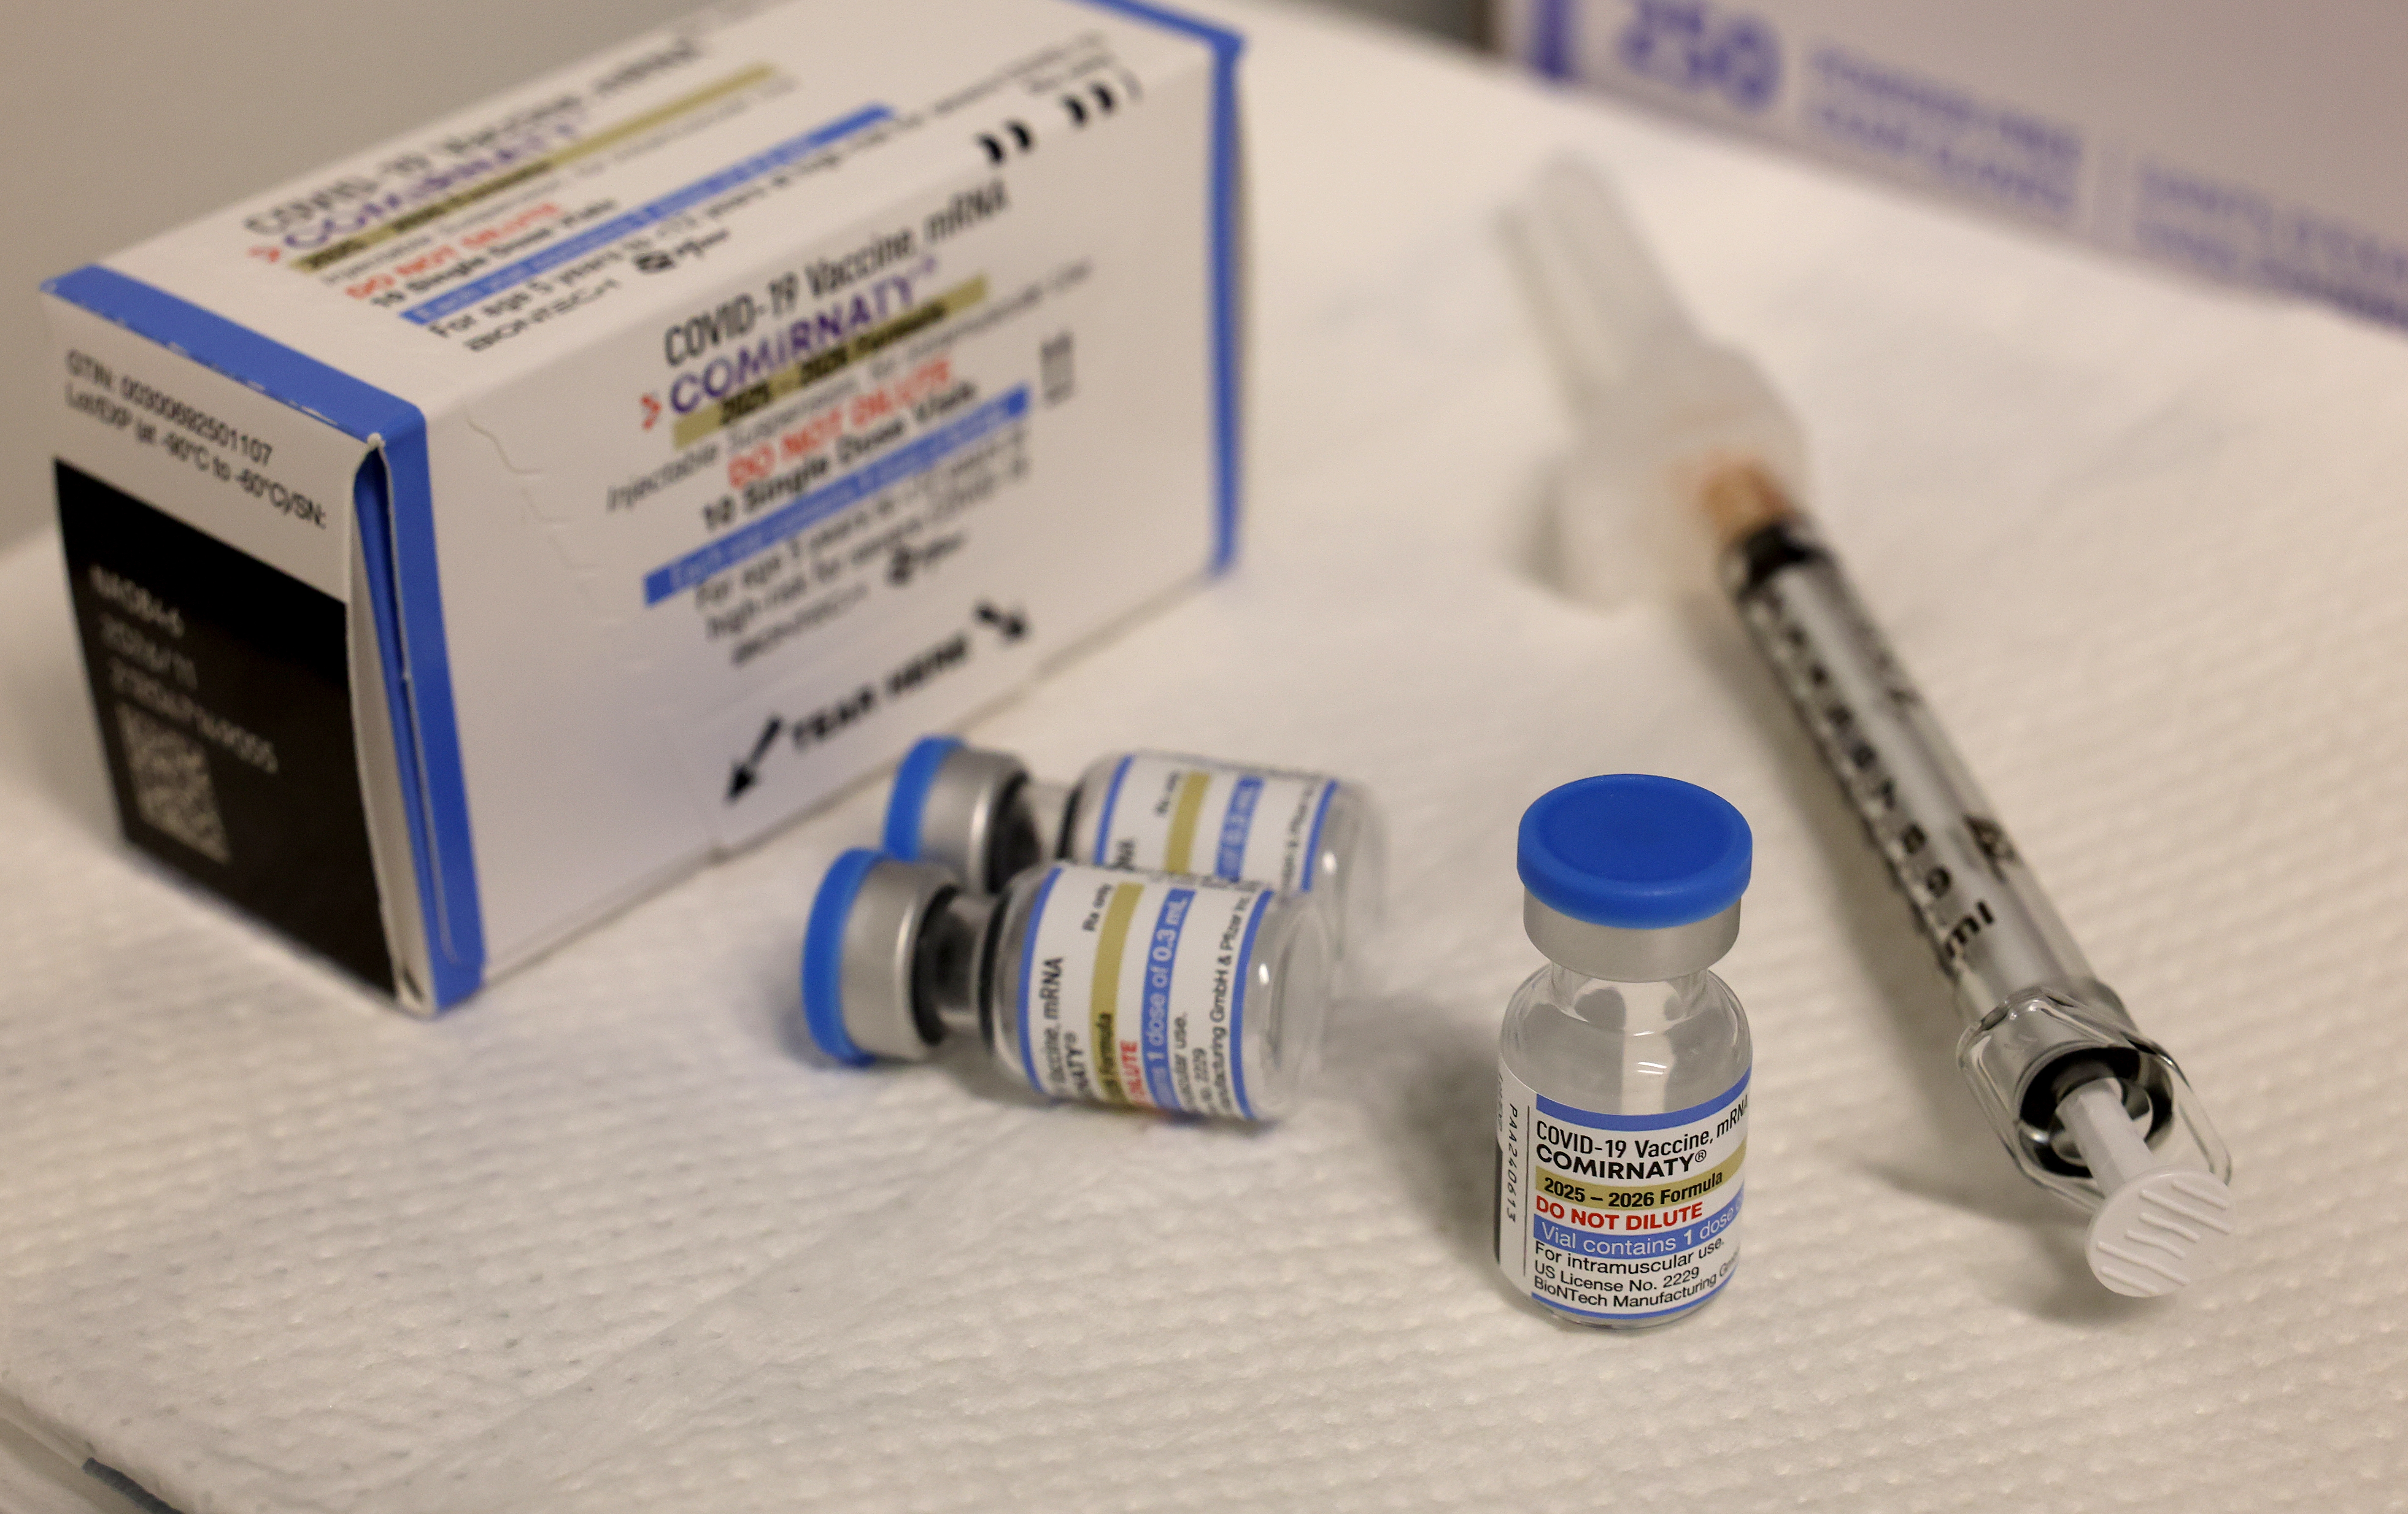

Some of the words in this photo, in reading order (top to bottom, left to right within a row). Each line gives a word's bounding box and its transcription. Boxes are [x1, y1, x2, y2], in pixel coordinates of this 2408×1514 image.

[664, 269, 799, 367] COVID-19
[924, 177, 1009, 245] mRNA
[727, 441, 777, 490] DO
[780, 403, 844, 464] NOT
[702, 494, 736, 532] 10
[742, 453, 831, 514] Single
[1081, 911, 1100, 932] Rx
[1220, 914, 1242, 951] Pfizer
[1152, 929, 1177, 962] 0.3
[1217, 955, 1232, 967] &
[1038, 955, 1064, 1020] mRNA
[1150, 965, 1169, 989] of
[1209, 969, 1228, 1023] GmbH
[1145, 993, 1167, 1046] dose
[1173, 1013, 1188, 1049] use.
[1147, 1052, 1164, 1061] 1
[1192, 1047, 1210, 1082] 2229
[1537, 1120, 1627, 1159] COVID-19
[1634, 1130, 1714, 1159] Vaccine,
[1506, 1103, 1518, 1223] PAA240613
[1536, 1143, 1707, 1180] COMIRNATY®
[1544, 1177, 1585, 1203] 2025
[1608, 1192, 1655, 1208] 2026
[1660, 1172, 1722, 1205] Formula
[1536, 1195, 1565, 1219] DO
[1571, 1208, 1620, 1230] NOT
[1625, 1201, 1703, 1231] DILUTE
[1542, 1221, 1576, 1249] Vial
[1583, 1237, 1676, 1255] contains
[1683, 1229, 1693, 1245] 1
[1699, 1207, 1733, 1240] dose
[1535, 1240, 1563, 1263] For
[1567, 1252, 1694, 1275] intramuscular
[1698, 1238, 1725, 1259] use.
[1534, 1275, 1608, 1307] BioNTech
[1613, 1273, 1717, 1308] Manufacturing
[1535, 1259, 1556, 1279] US
[1560, 1270, 1624, 1292] License
[1629, 1279, 1657, 1292] No.
[1663, 1266, 1700, 1288] 2229
